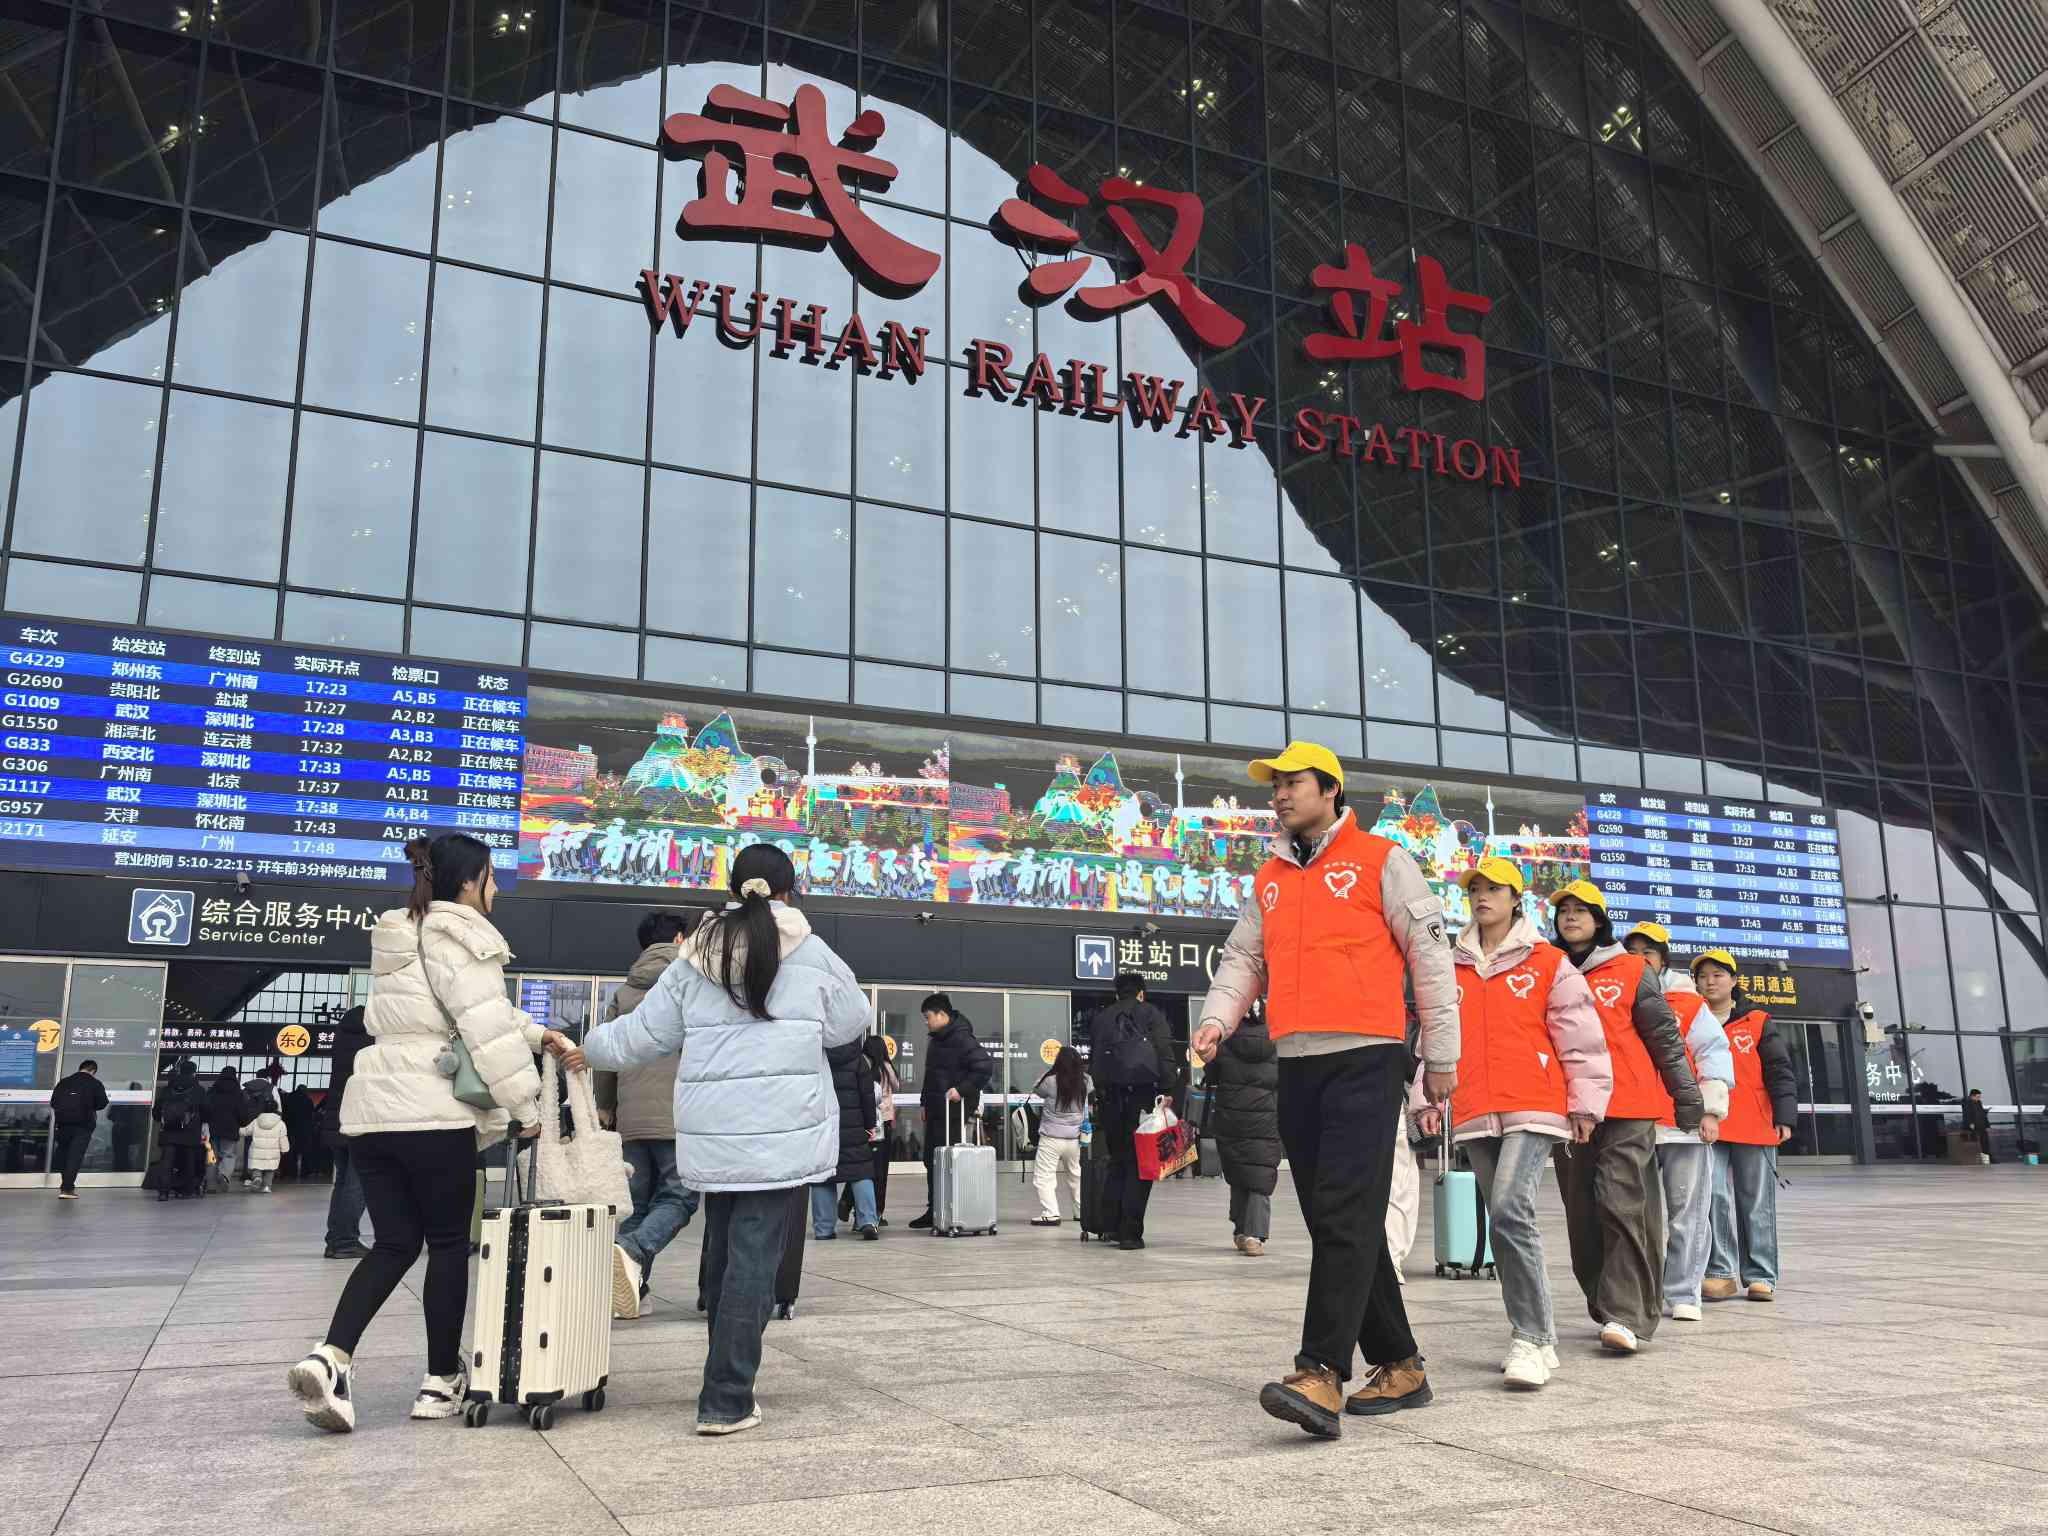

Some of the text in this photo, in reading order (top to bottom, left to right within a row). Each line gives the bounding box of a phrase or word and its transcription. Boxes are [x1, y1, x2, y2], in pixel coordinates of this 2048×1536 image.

[660, 83, 1491, 400] 武汉站
[637, 269, 1521, 488] WUHAN RAILWAY STATION
[20, 627, 509, 690] 车次 始发站 终到站 实际开点 检票口 状态
[8, 673, 520, 733] G2690 贵阳北 盐城 17:27 A2,B2 正在候车
[9, 652, 521, 715] G4229 郑州东 广州南 17:23 A5,B5 正在候车
[2, 715, 518, 771] G1550 湘潭北 连云港 17:32 A2,B2 正在候车
[5, 694, 519, 752] G1009 武汉 深圳北 17:28 A3,B3 正在候车
[3, 757, 515, 810] G306 广州南 北京 17:37 A1,B1 正在候车
[5, 736, 517, 791] G833 西安北 深圳北 17:33 A5,B5 正在候车
[0, 800, 43, 815] G957
[104, 808, 139, 824] 天津
[195, 813, 245, 831] 怀化南
[294, 821, 336, 835] 17:43
[383, 827, 427, 841] A5,B5
[107, 787, 141, 802] 武汉
[196, 792, 247, 810] 深圳北
[296, 800, 338, 815] 17:38
[384, 807, 429, 821] A4,B4
[456, 812, 515, 829] 正在候车
[0, 822, 45, 838] 2171
[102, 829, 136, 845] 延安
[201, 835, 234, 851] 广州
[292, 841, 335, 855] 17:48
[114, 853, 387, 881] 营业时间 5:10-22:15 开车前3分钟停止检票
[1736, 864, 1756, 875] 17:32
[1605, 881, 1627, 892] G306
[1738, 891, 1758, 902] 17:37
[201, 897, 380, 931] 综合服务中心
[1607, 910, 1628, 922] G957
[1741, 919, 1761, 930] 17:43
[199, 928, 325, 945] Service Center
[1119, 938, 1224, 981] 进站口(
[1738, 974, 1796, 994] 专用通道
[72, 1027, 116, 1038] 安全检查
[280, 1032, 307, 1048] 东6
[1866, 1060, 1925, 1086] 务中心
